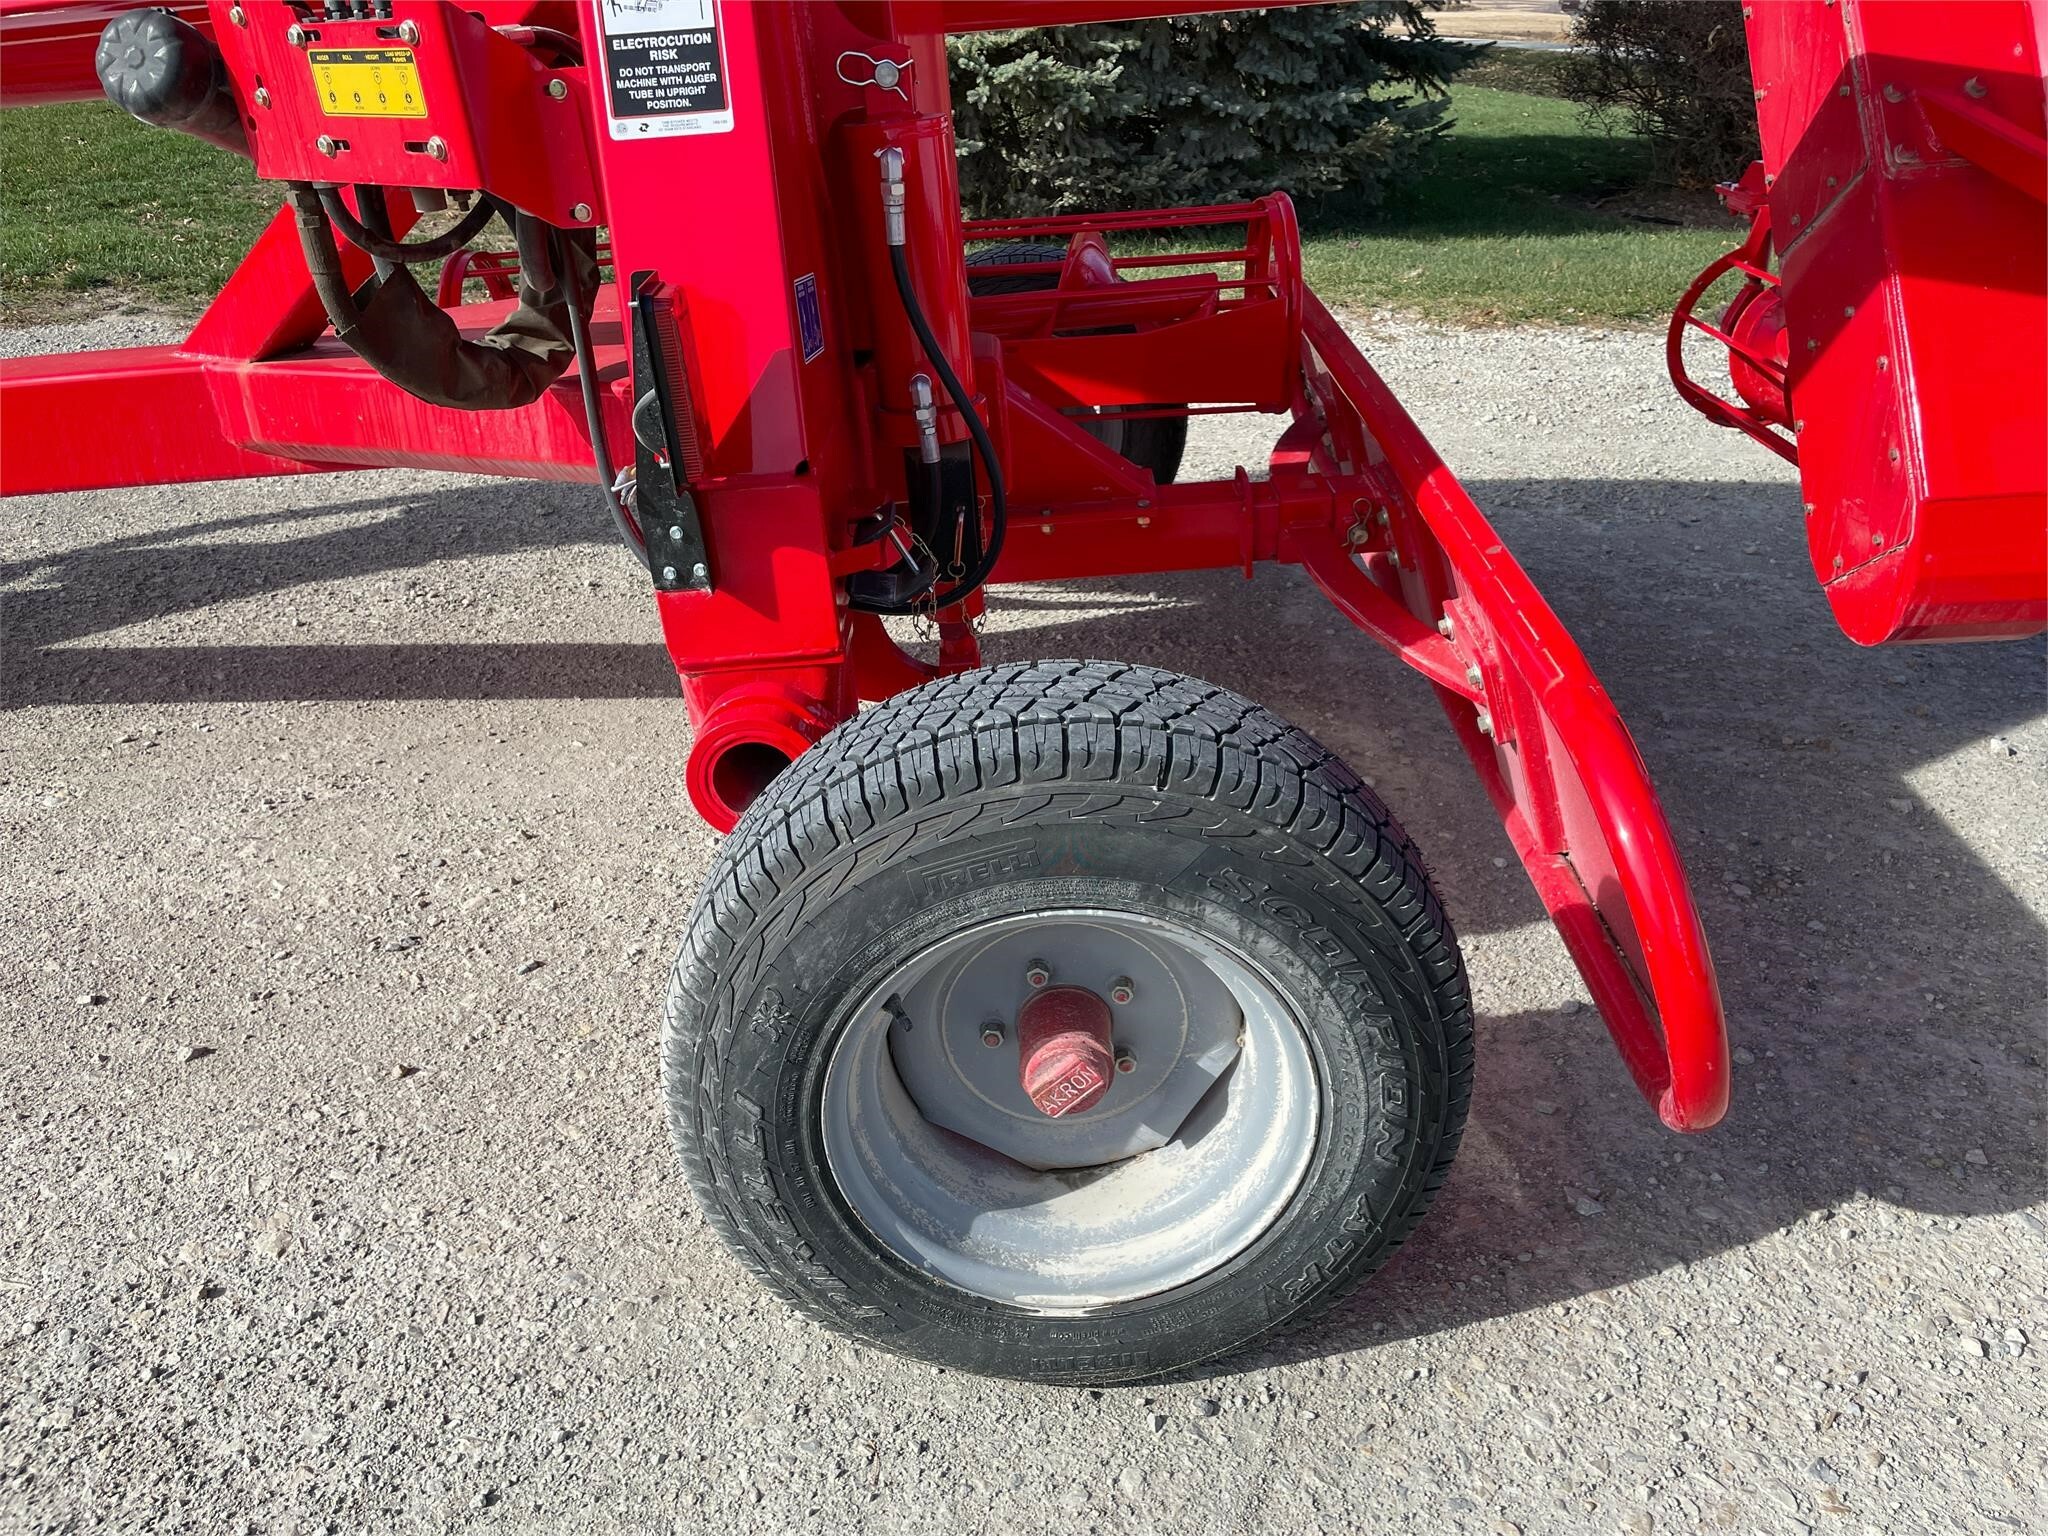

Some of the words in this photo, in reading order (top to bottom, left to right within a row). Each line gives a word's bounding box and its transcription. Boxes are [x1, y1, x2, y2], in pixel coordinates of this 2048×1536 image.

[613, 33, 712, 50] ELECTROCUTION
[650, 48, 678, 61] RISK
[620, 68, 633, 77] DO
[635, 66, 654, 76] NOT
[656, 62, 711, 75] TRANSPORT
[616, 77, 658, 89] MACHINE
[660, 76, 682, 86] WITH
[685, 73, 716, 83] AUGER
[629, 89, 654, 99] TUBE
[656, 88, 665, 97] IN
[667, 86, 706, 97] UPRIGHT
[647, 99, 692, 109] POSITION.
[1206, 866, 1408, 1167] SCORPION
[1041, 1066, 1098, 1114] AKRON
[733, 1088, 887, 1320] PIRELLI
[1282, 1192, 1376, 1301] ATR
